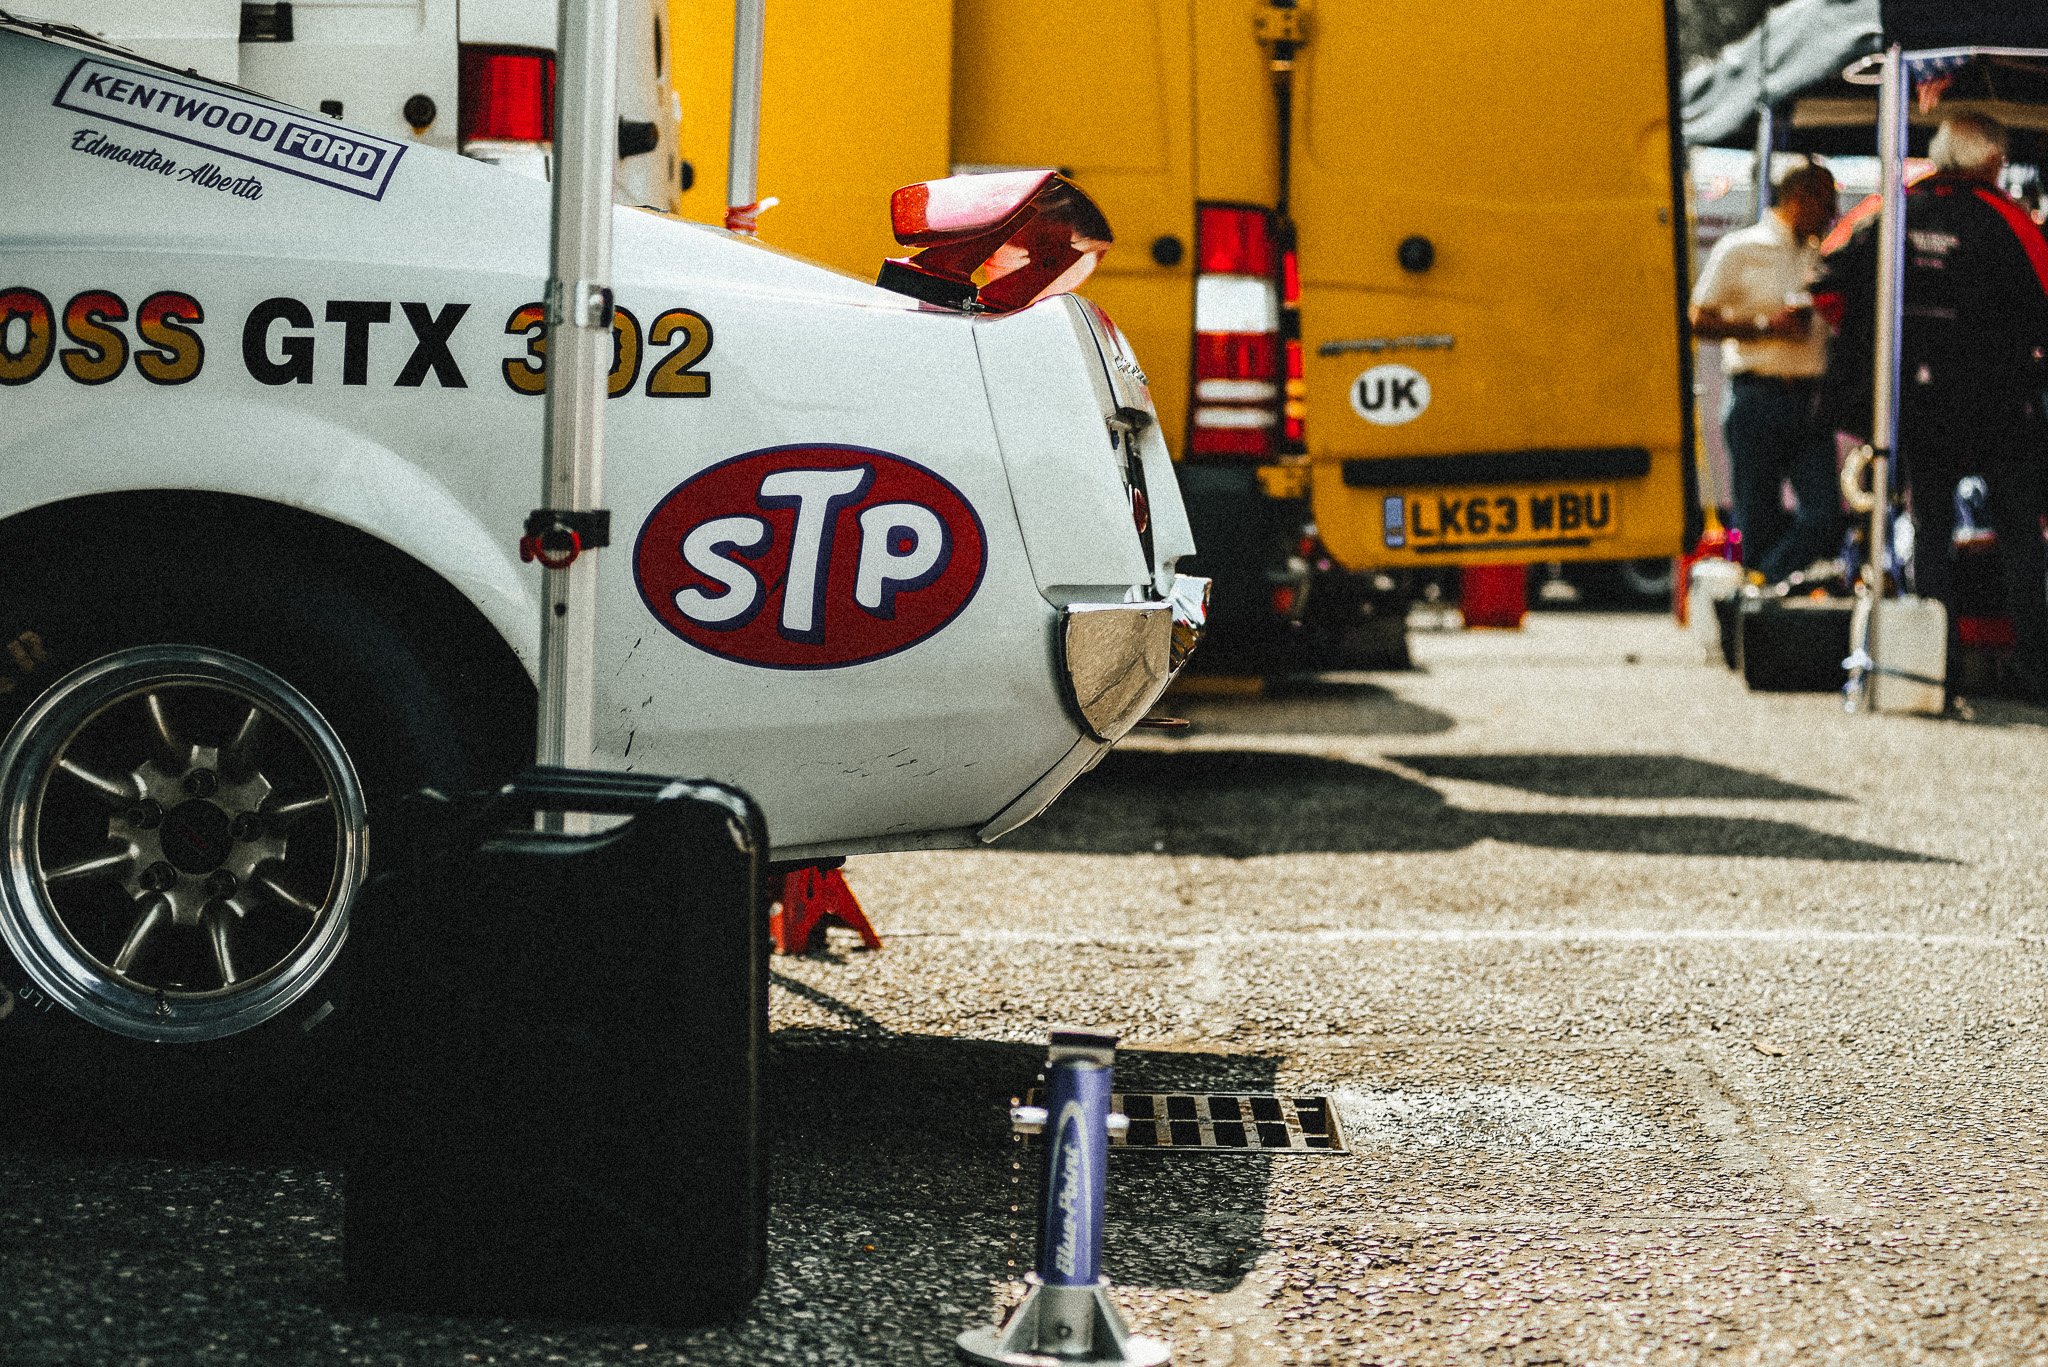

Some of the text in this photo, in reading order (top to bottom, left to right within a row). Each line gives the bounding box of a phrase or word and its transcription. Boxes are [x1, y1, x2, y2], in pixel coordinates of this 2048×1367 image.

[82, 72, 377, 174] KENTWOOD FORD
[71, 129, 264, 201] Edmonton Alberta
[242, 296, 472, 389] GTX
[1358, 376, 1420, 411] UK
[670, 462, 953, 646] STP
[1411, 491, 1610, 538] LK63 WBU
